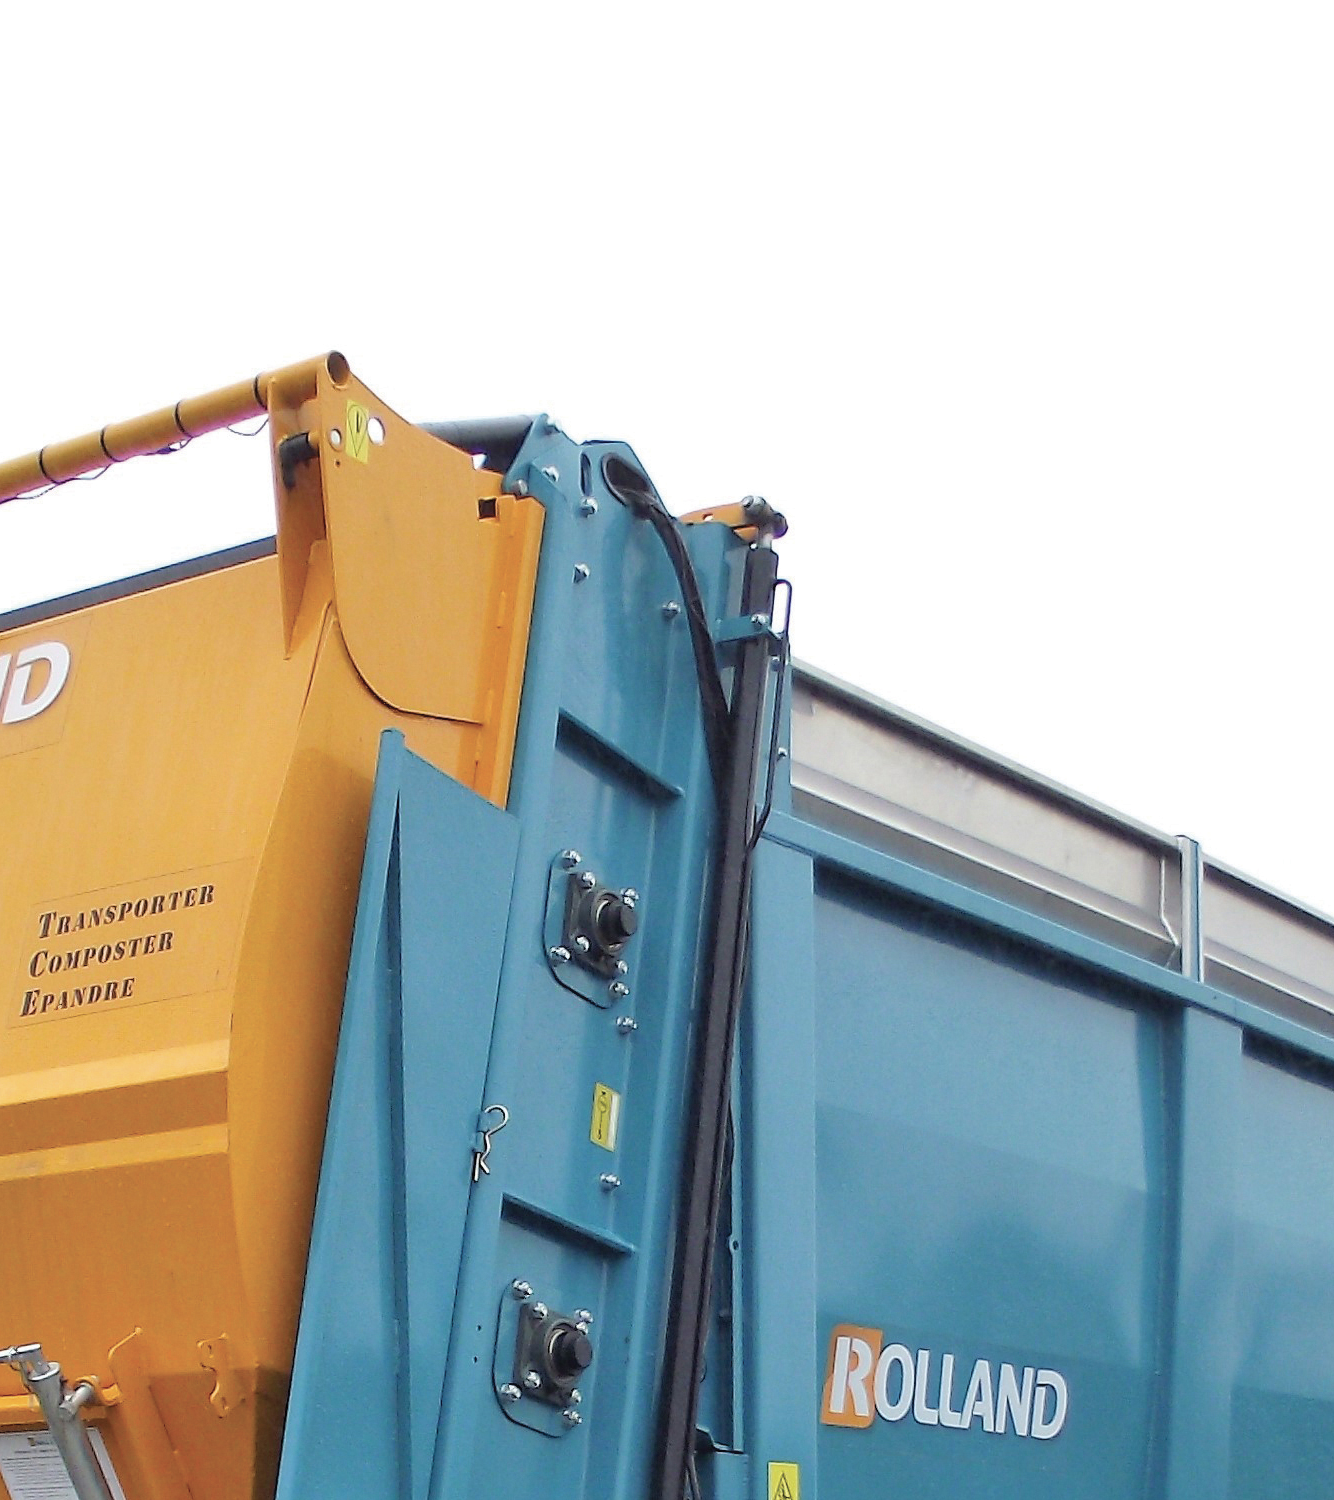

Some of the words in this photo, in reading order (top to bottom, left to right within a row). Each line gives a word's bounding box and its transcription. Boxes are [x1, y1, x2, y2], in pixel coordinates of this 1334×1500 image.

[39, 884, 215, 939] TRANSPORTER
[29, 931, 175, 978] COMPOSTER
[20, 977, 136, 1017] EPANDRE
[828, 1335, 1069, 1440] ROLLAND
